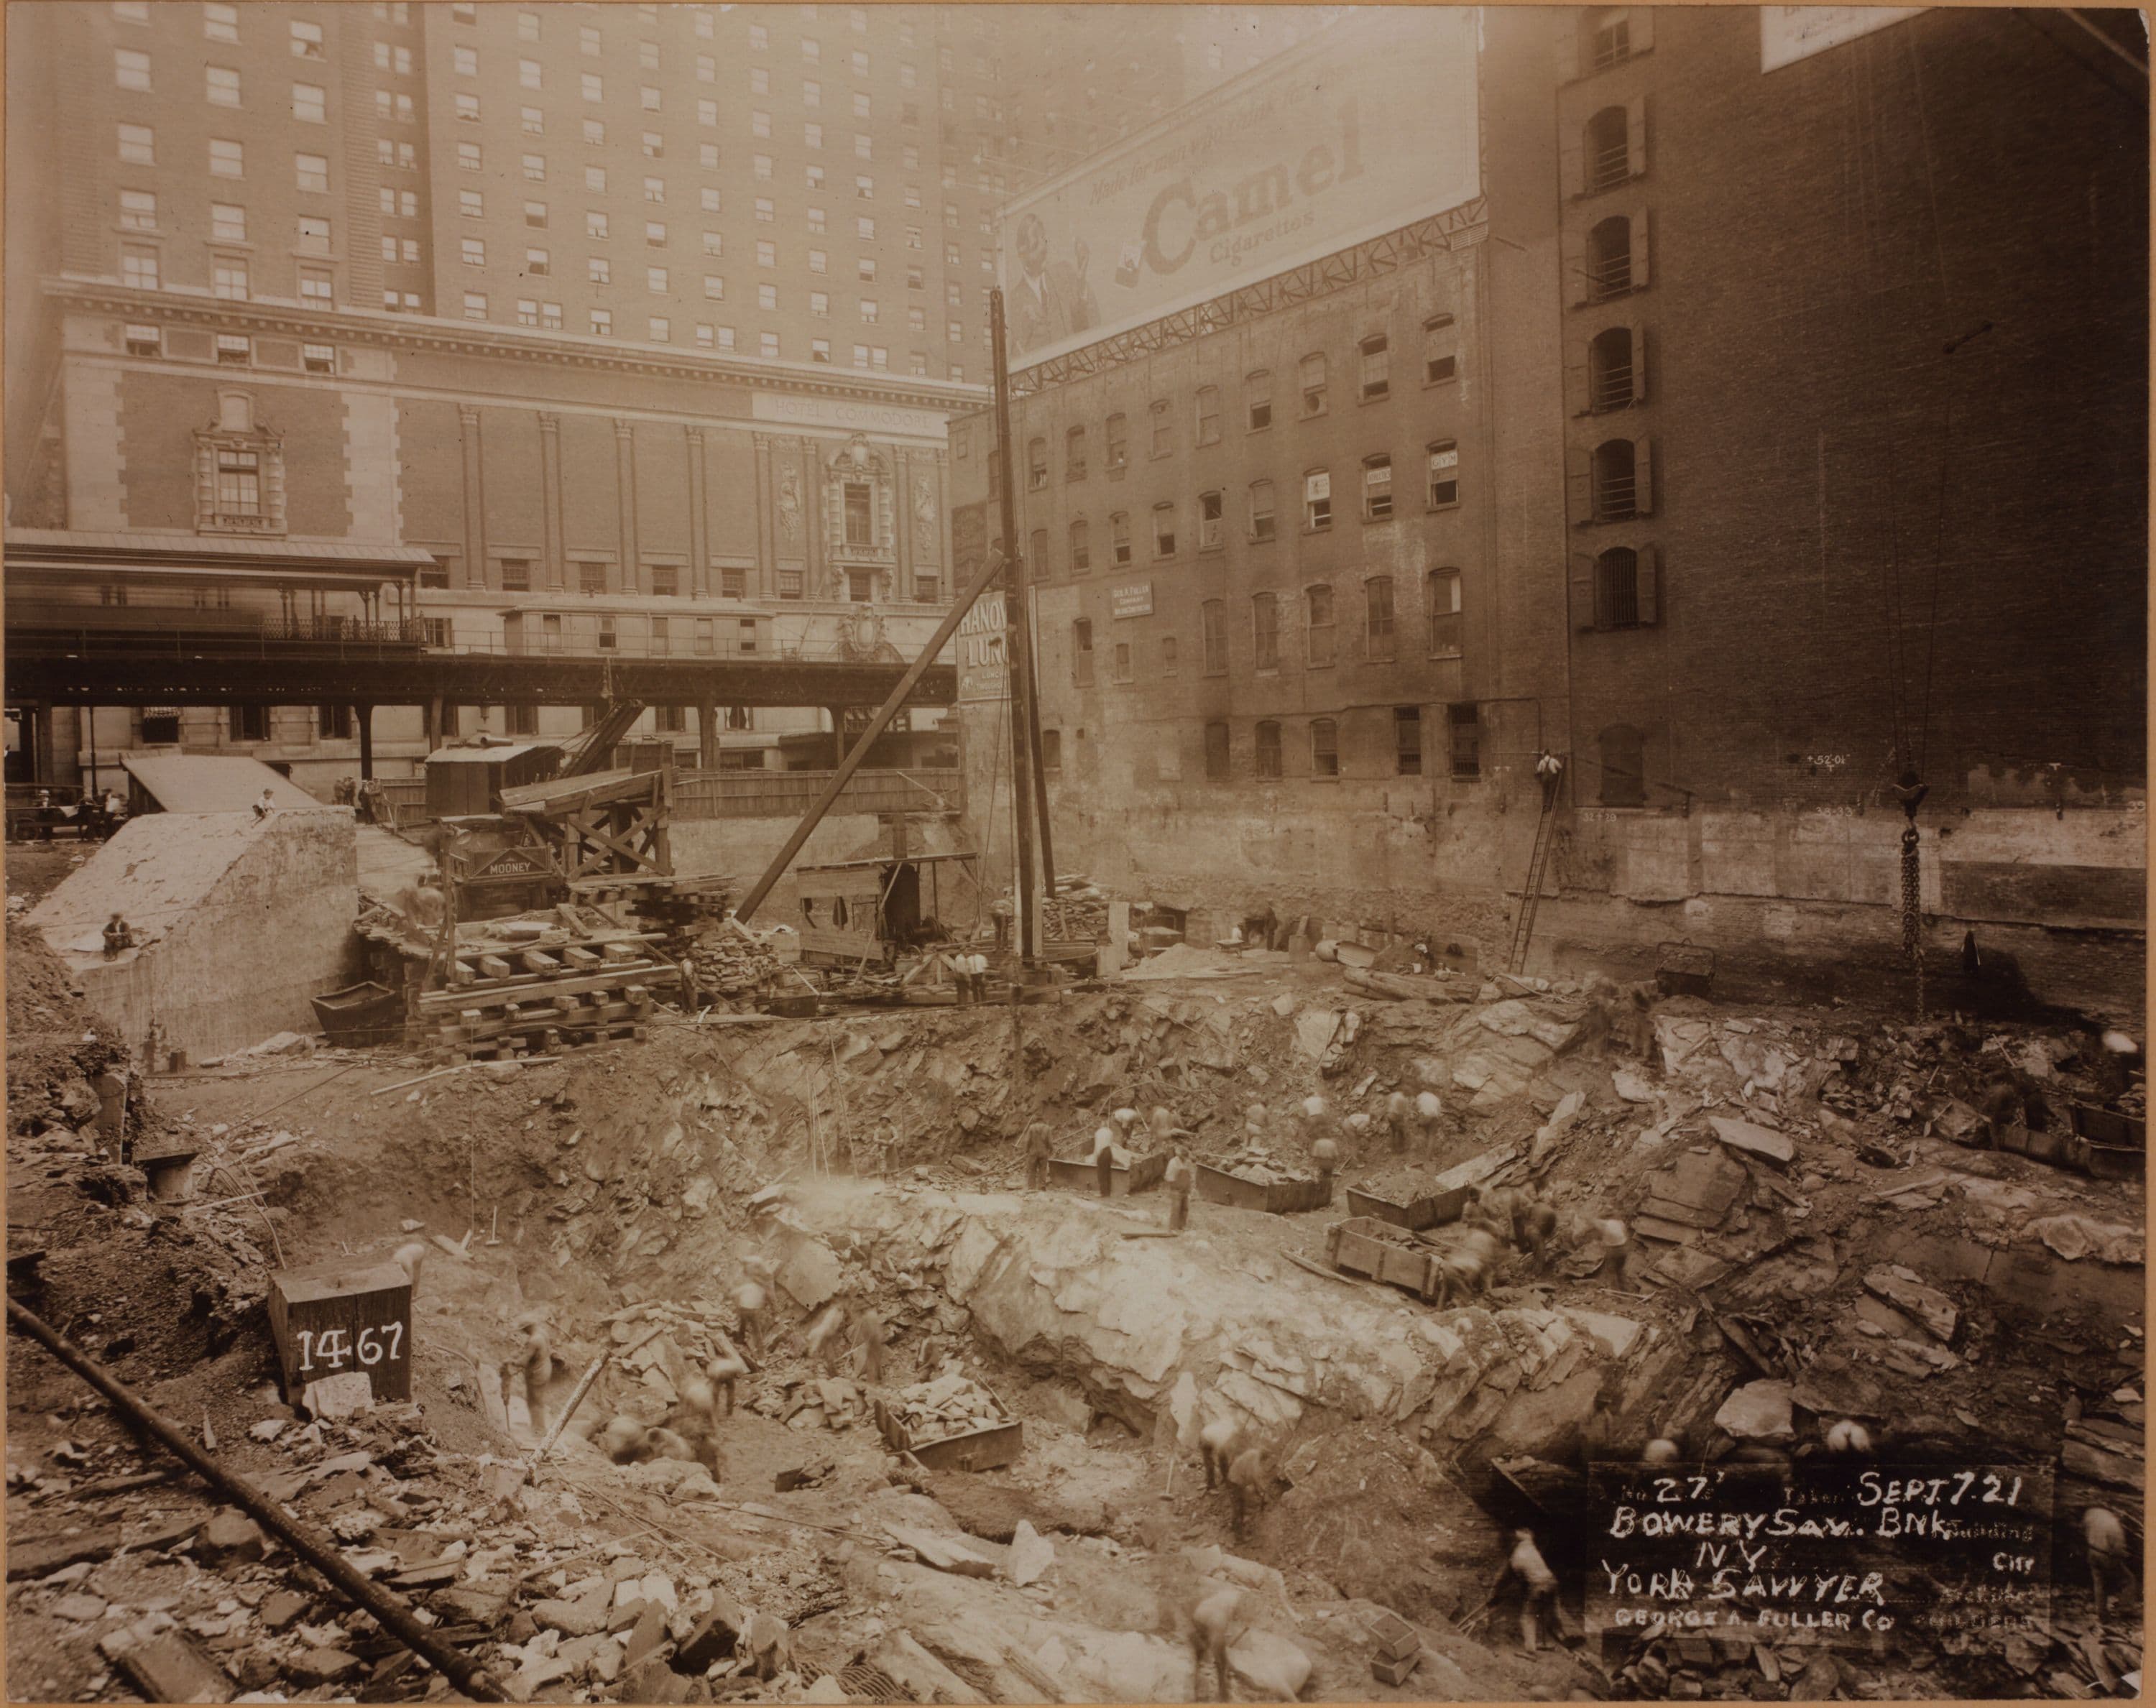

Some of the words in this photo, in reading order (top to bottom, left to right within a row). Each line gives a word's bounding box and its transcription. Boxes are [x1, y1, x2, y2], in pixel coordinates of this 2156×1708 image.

[1142, 96, 1365, 275] Camel
[1210, 210, 1315, 267] Cigarettes
[775, 400, 824, 418] HOTEL
[835, 407, 932, 428] COMMODORE
[490, 862, 530, 874] MOONEY
[297, 1321, 402, 1371] 1467
